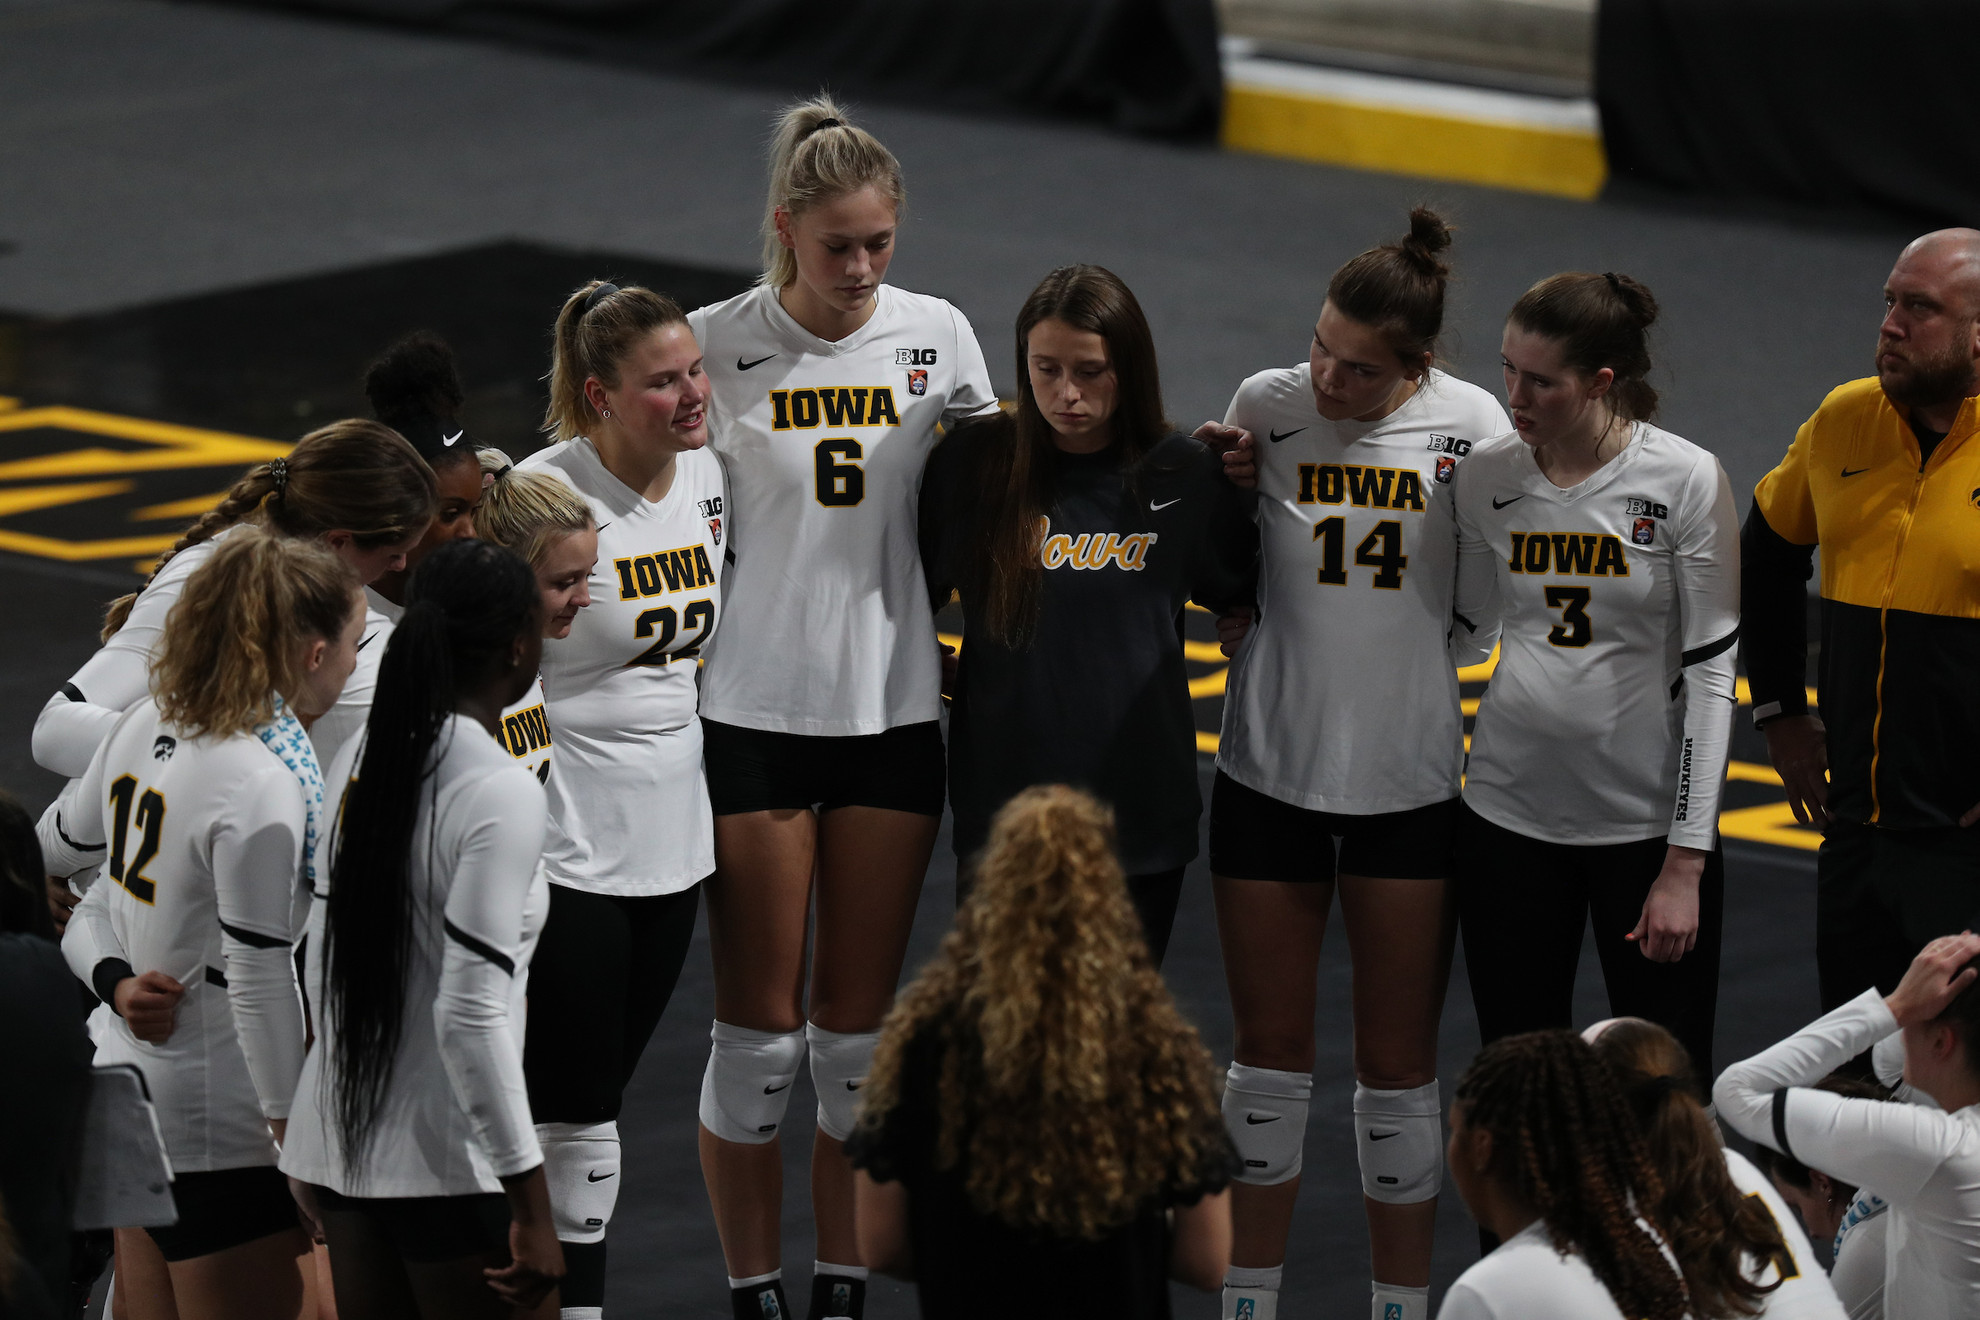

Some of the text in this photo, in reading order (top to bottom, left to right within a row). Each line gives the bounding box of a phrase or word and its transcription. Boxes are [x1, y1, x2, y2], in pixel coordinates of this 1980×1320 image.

[769, 386, 901, 431] IOWA
[814, 437, 865, 508] 6
[1297, 463, 1426, 512] IOWA
[613, 543, 716, 601] IOWA
[1312, 515, 1408, 591] 14
[1508, 531, 1630, 577] IOWA
[623, 599, 715, 667] 22
[1543, 585, 1594, 648] 3
[1675, 737, 1693, 821] HAWKEYES
[109, 772, 167, 906] 12
